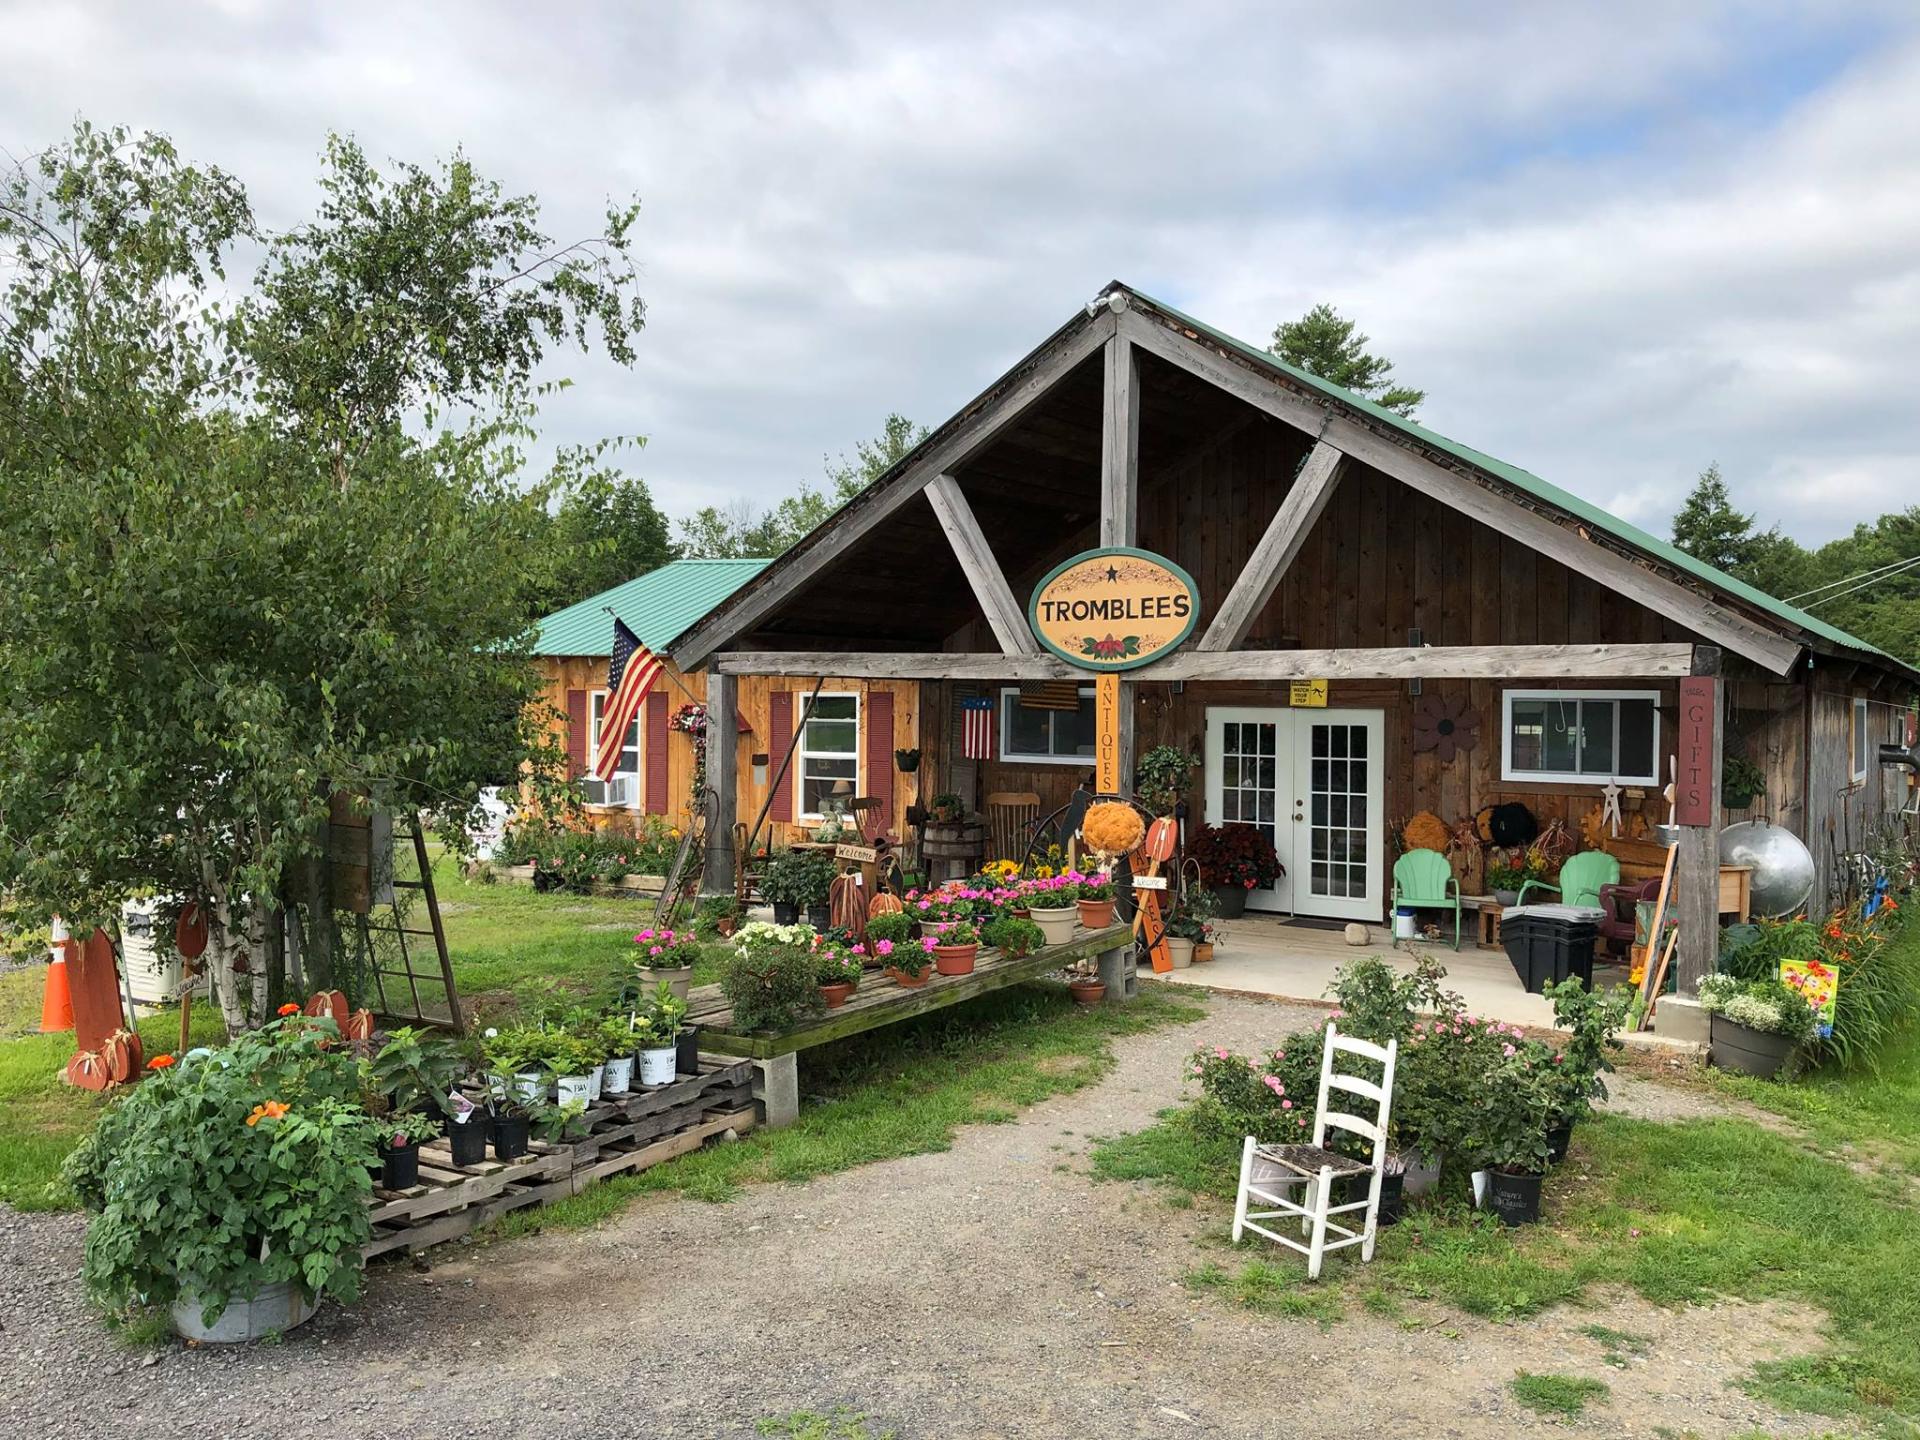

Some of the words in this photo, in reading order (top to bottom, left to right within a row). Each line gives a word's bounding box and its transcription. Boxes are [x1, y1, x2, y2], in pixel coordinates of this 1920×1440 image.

[1041, 594, 1190, 622] TROMBLEES
[1101, 678, 1113, 790] ANTIQUES
[1688, 705, 1703, 807] GIFTS
